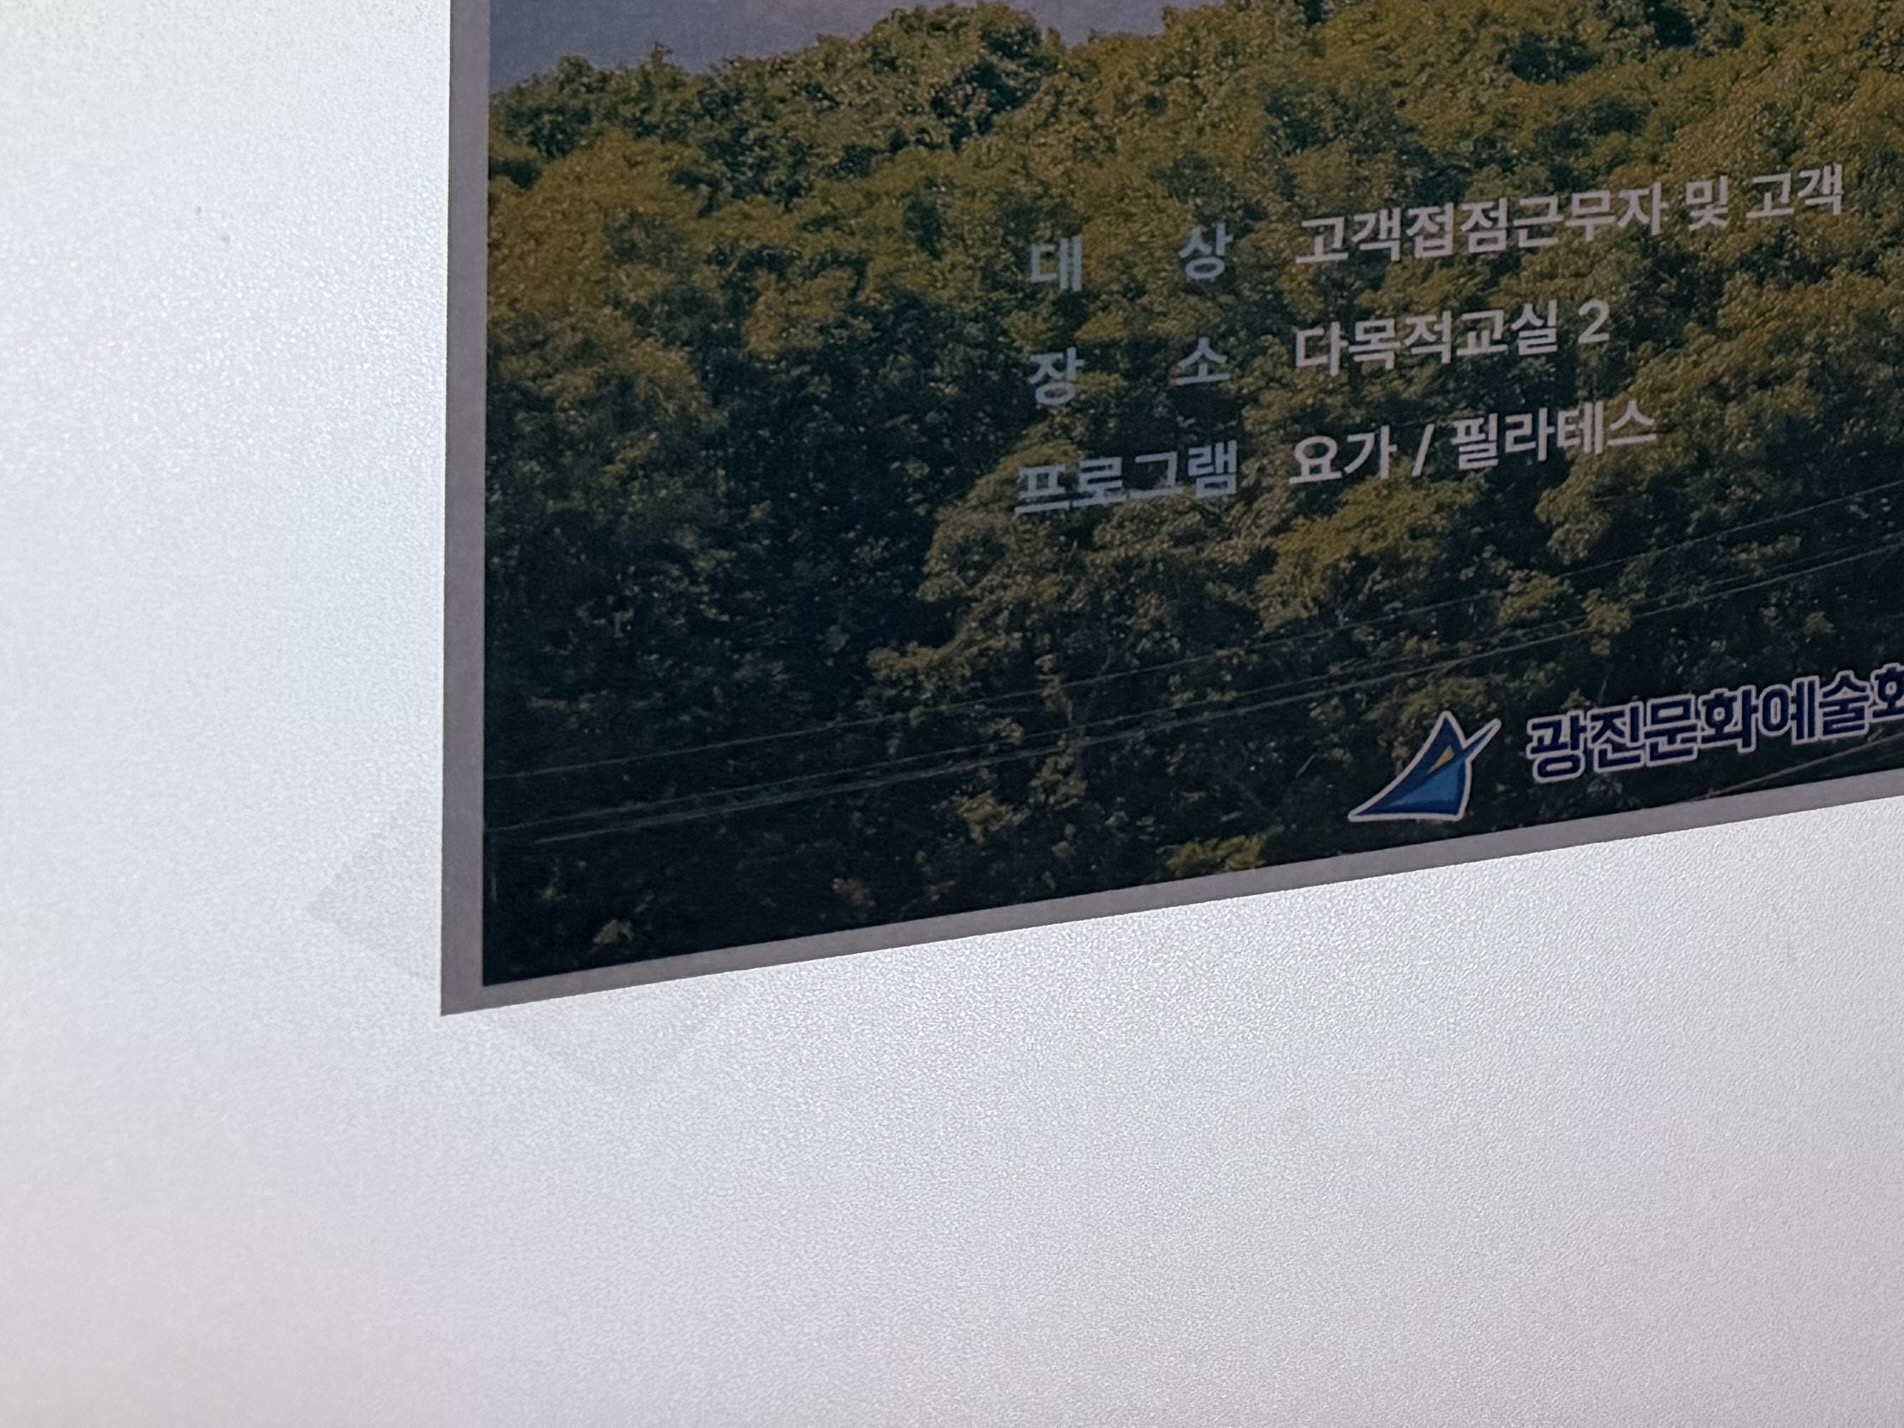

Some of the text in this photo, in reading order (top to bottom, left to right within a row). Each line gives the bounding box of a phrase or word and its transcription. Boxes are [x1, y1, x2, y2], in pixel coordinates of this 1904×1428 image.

[1029, 163, 1845, 294] 대 상 고객접점근무자 및 고객
[1026, 298, 1613, 409] 장 소 다목적교실 2
[1013, 397, 1659, 517] 프로그램 요가 / 필라테스
